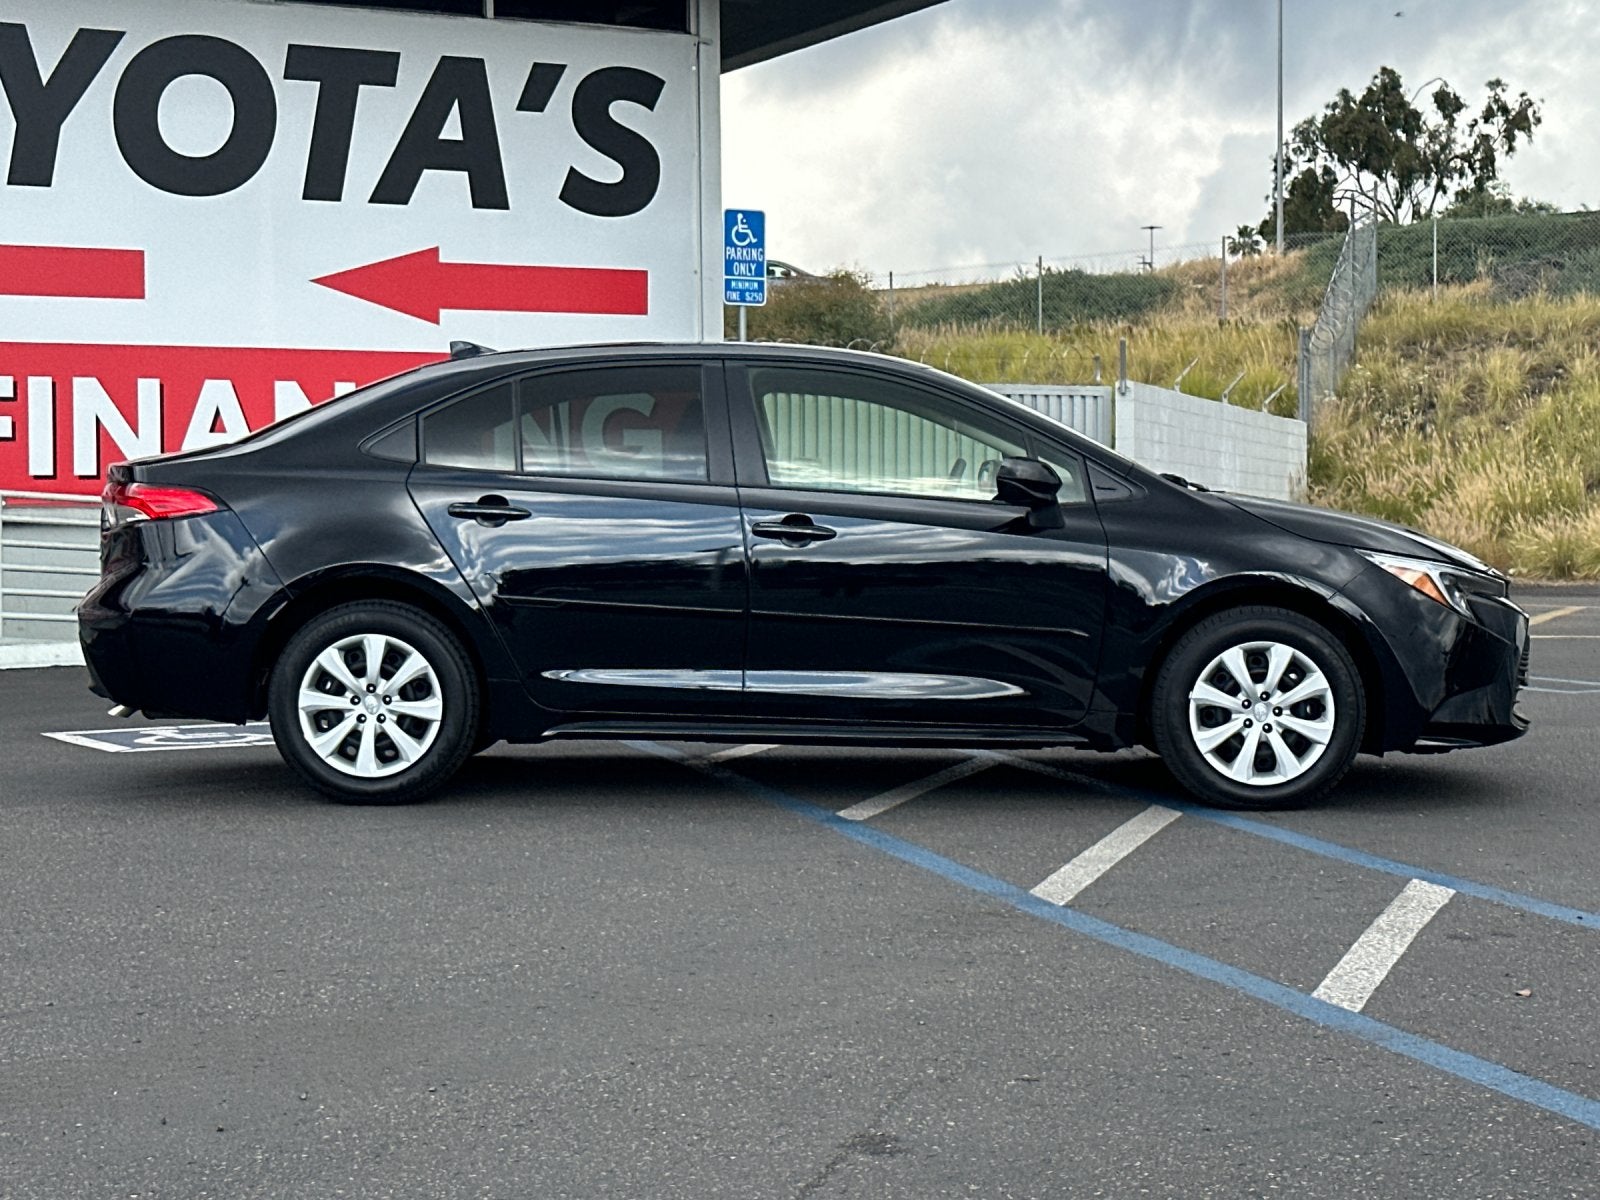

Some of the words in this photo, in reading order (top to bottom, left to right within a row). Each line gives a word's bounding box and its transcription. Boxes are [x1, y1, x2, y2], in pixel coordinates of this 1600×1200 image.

[726, 246, 764, 262] PARKING
[733, 262, 757, 276] ONLY
[731, 280, 759, 290] MINIMUM
[726, 291, 741, 301] FINE
[745, 292, 763, 302] $250
